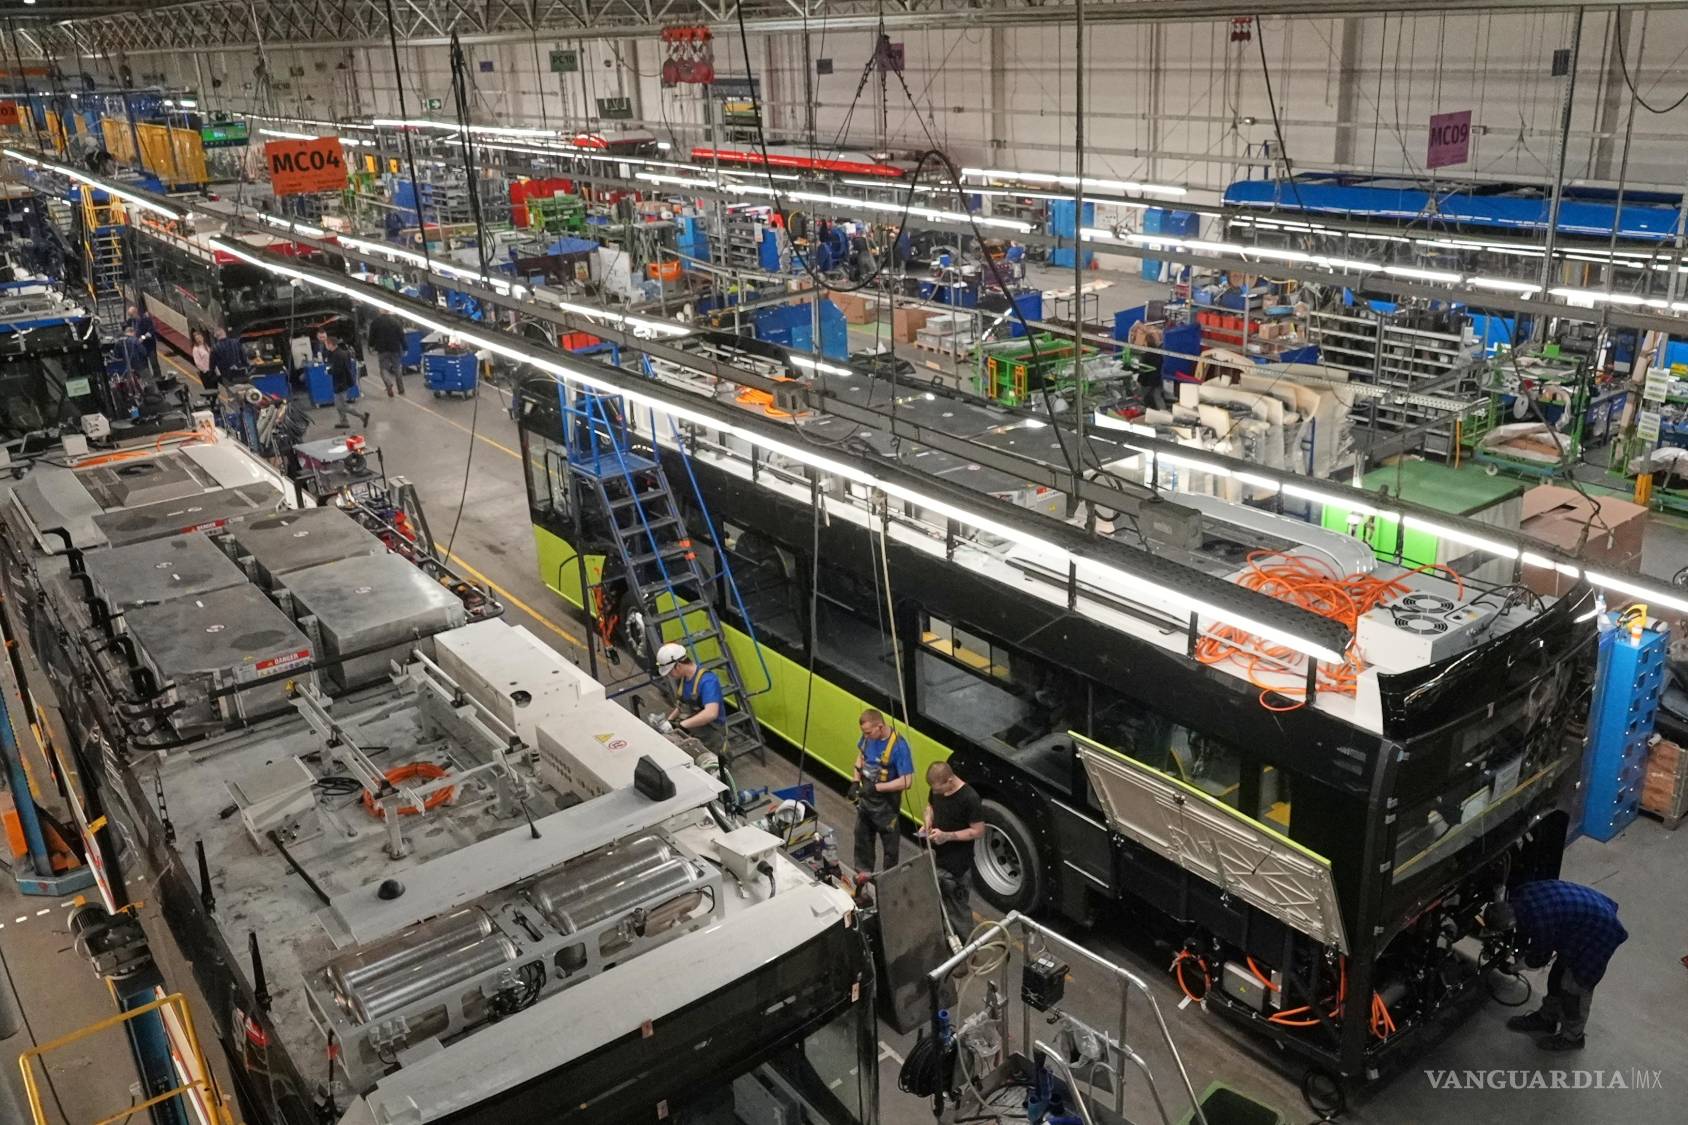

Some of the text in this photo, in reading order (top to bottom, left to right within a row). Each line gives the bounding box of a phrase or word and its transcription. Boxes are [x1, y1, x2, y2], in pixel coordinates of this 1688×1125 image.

[1430, 123, 1468, 146] MC09
[272, 150, 340, 174] MC04
[274, 653, 299, 664] DANGER
